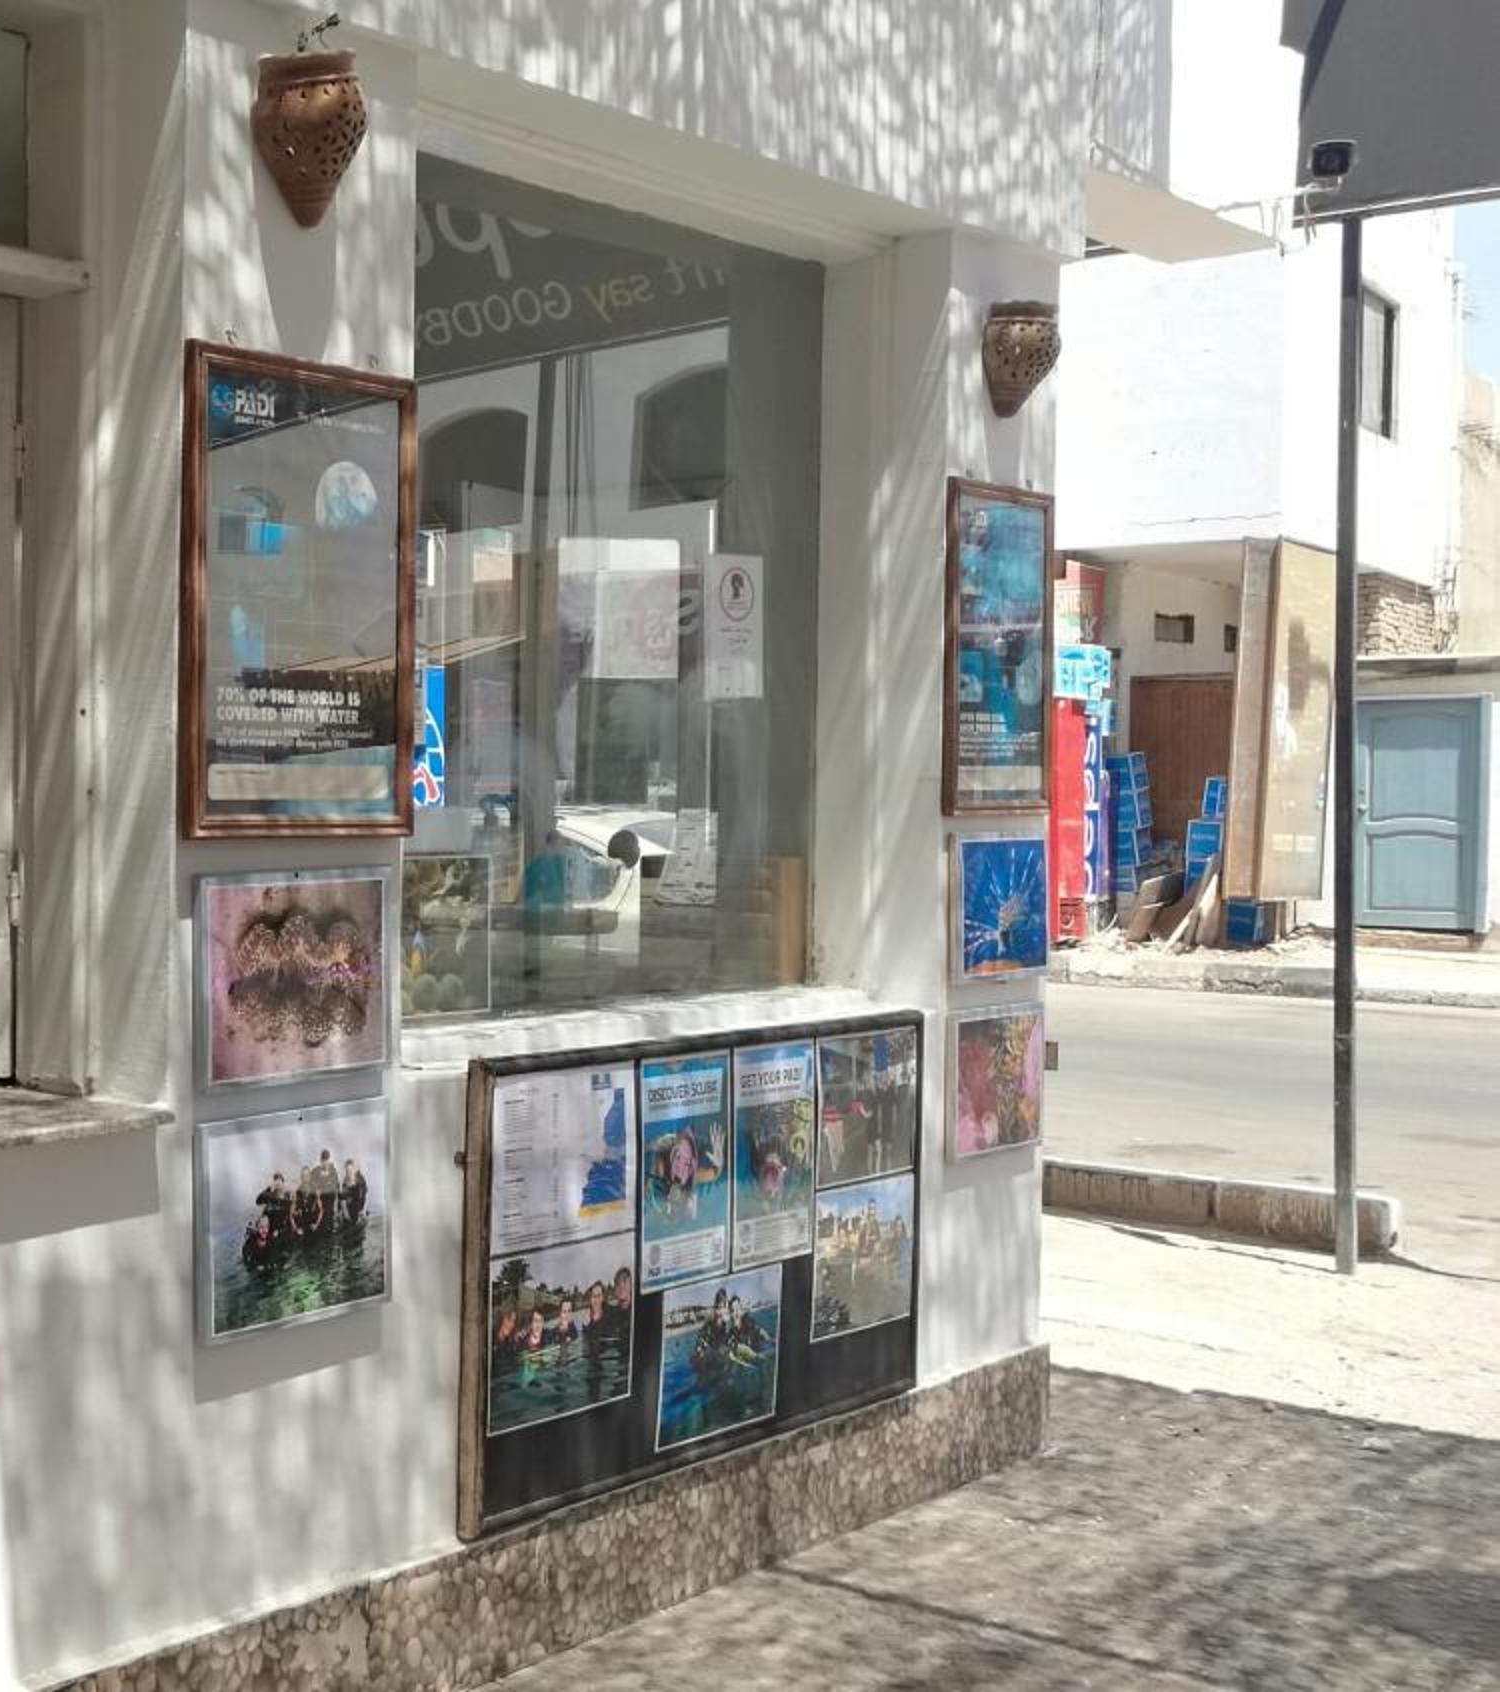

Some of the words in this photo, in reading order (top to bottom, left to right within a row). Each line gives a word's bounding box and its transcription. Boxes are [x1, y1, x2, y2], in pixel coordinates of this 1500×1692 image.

[235, 388, 276, 419] PADI
[217, 686, 246, 702] 70%
[250, 687, 269, 703] OF
[270, 688, 295, 705] THE
[297, 689, 345, 707] WORLD
[347, 691, 362, 708] IS
[216, 704, 278, 722] COVERED
[281, 707, 316, 723] WITH
[317, 708, 361, 725] WATER
